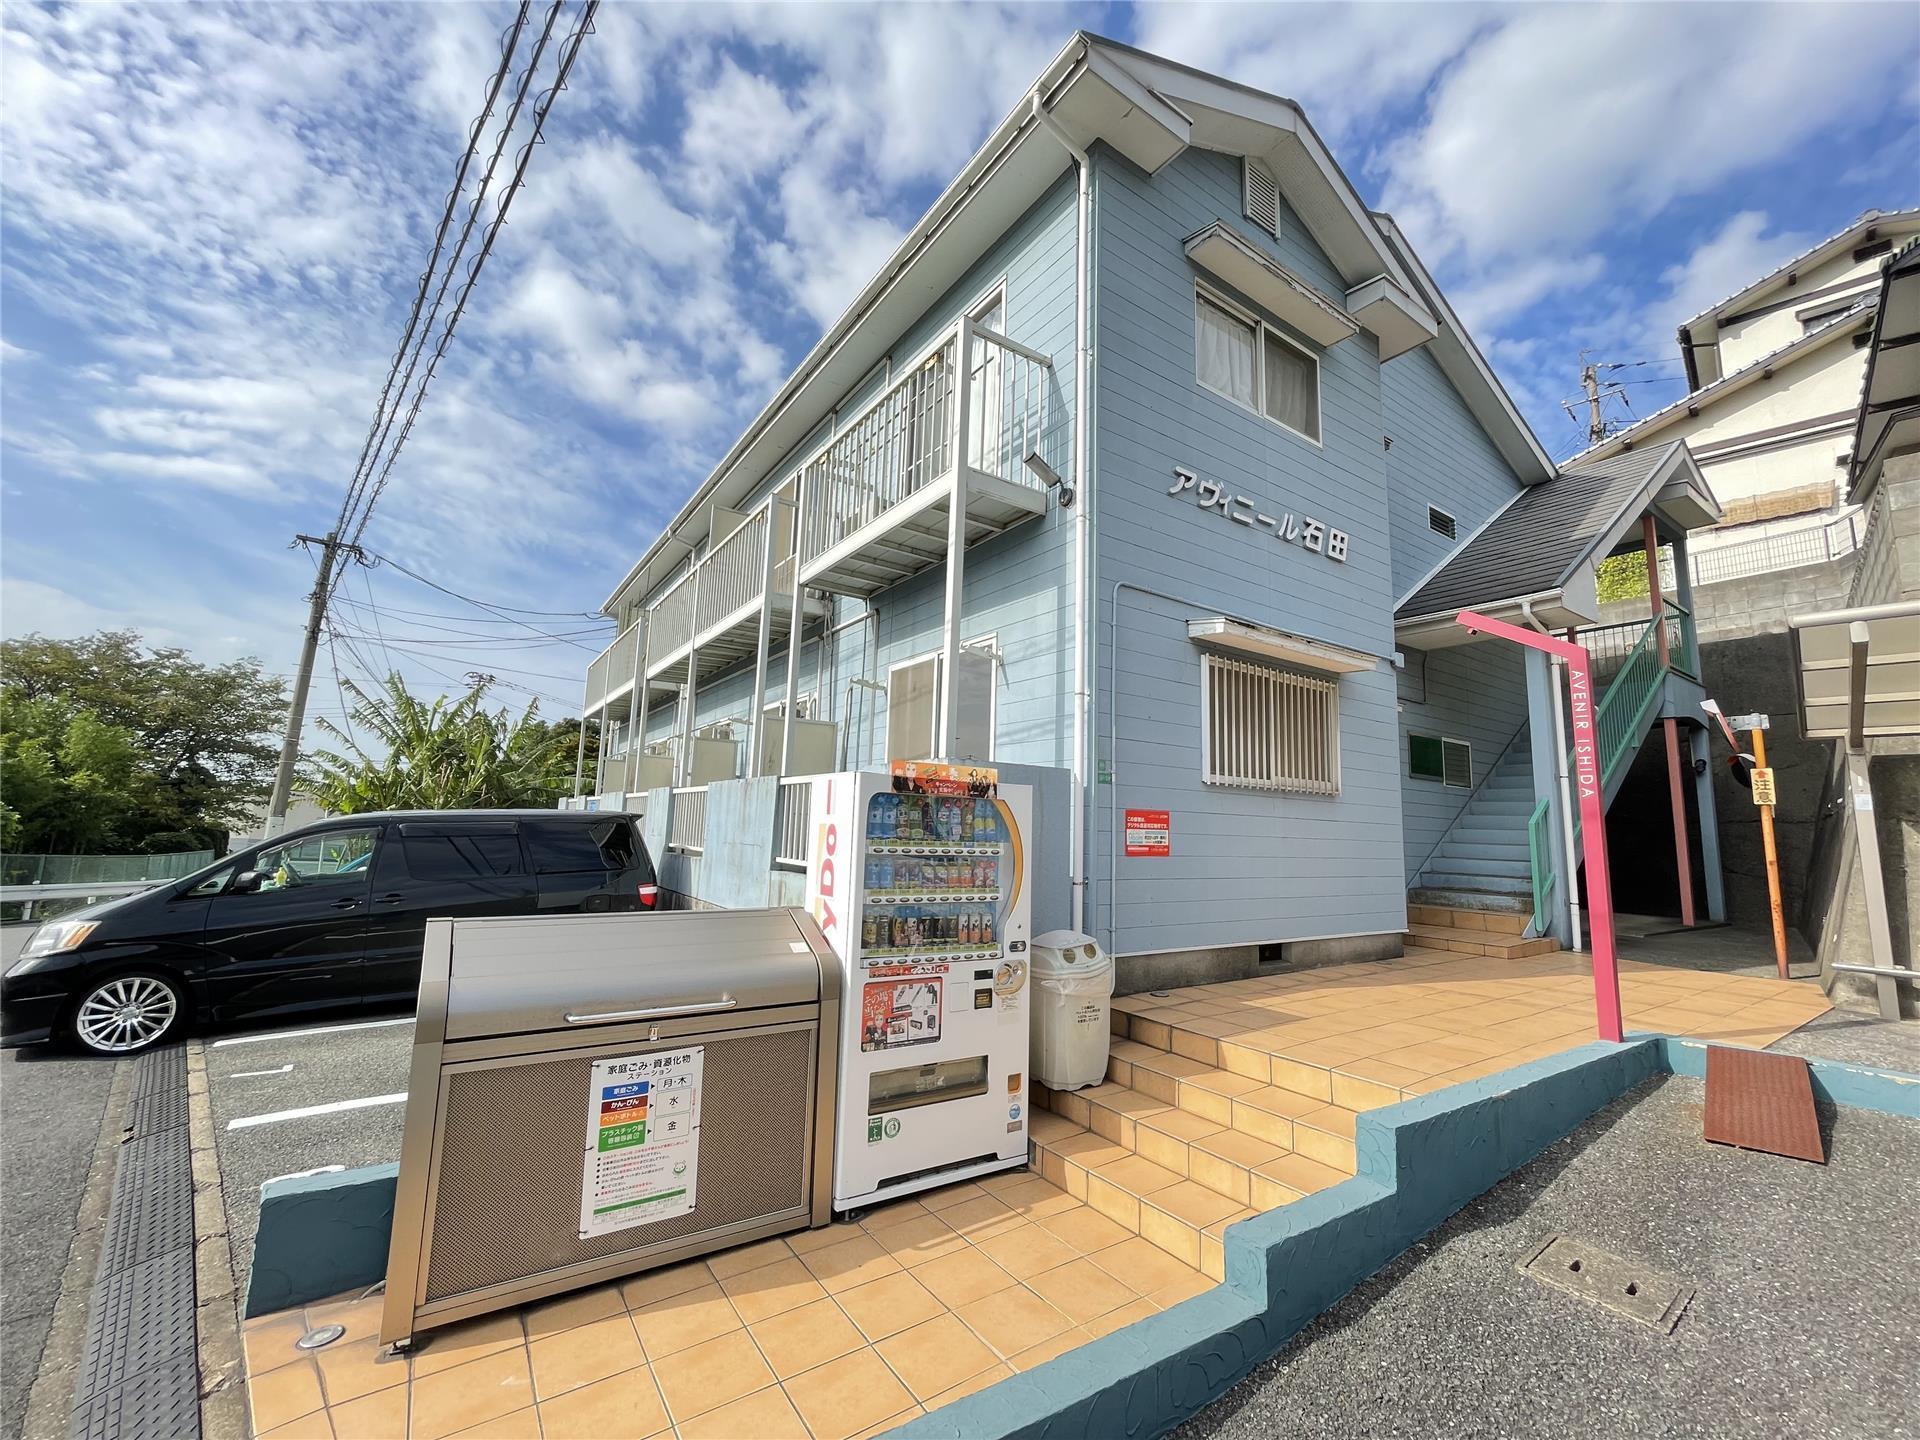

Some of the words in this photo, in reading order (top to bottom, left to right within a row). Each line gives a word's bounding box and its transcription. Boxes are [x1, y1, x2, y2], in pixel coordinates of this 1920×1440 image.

[1168, 465, 1349, 563] アヴィニール石田
[1572, 670, 1589, 729] AVENIR
[1578, 739, 1595, 798] ISHIDA
[1754, 779, 1773, 803] 注意
[607, 1054, 691, 1075] 家庭ごみ・資源化物
[627, 1067, 672, 1080] ステーション
[613, 1085, 639, 1095] 家庭ごみ
[669, 1095, 679, 1106] 水
[667, 1120, 677, 1131] 金
